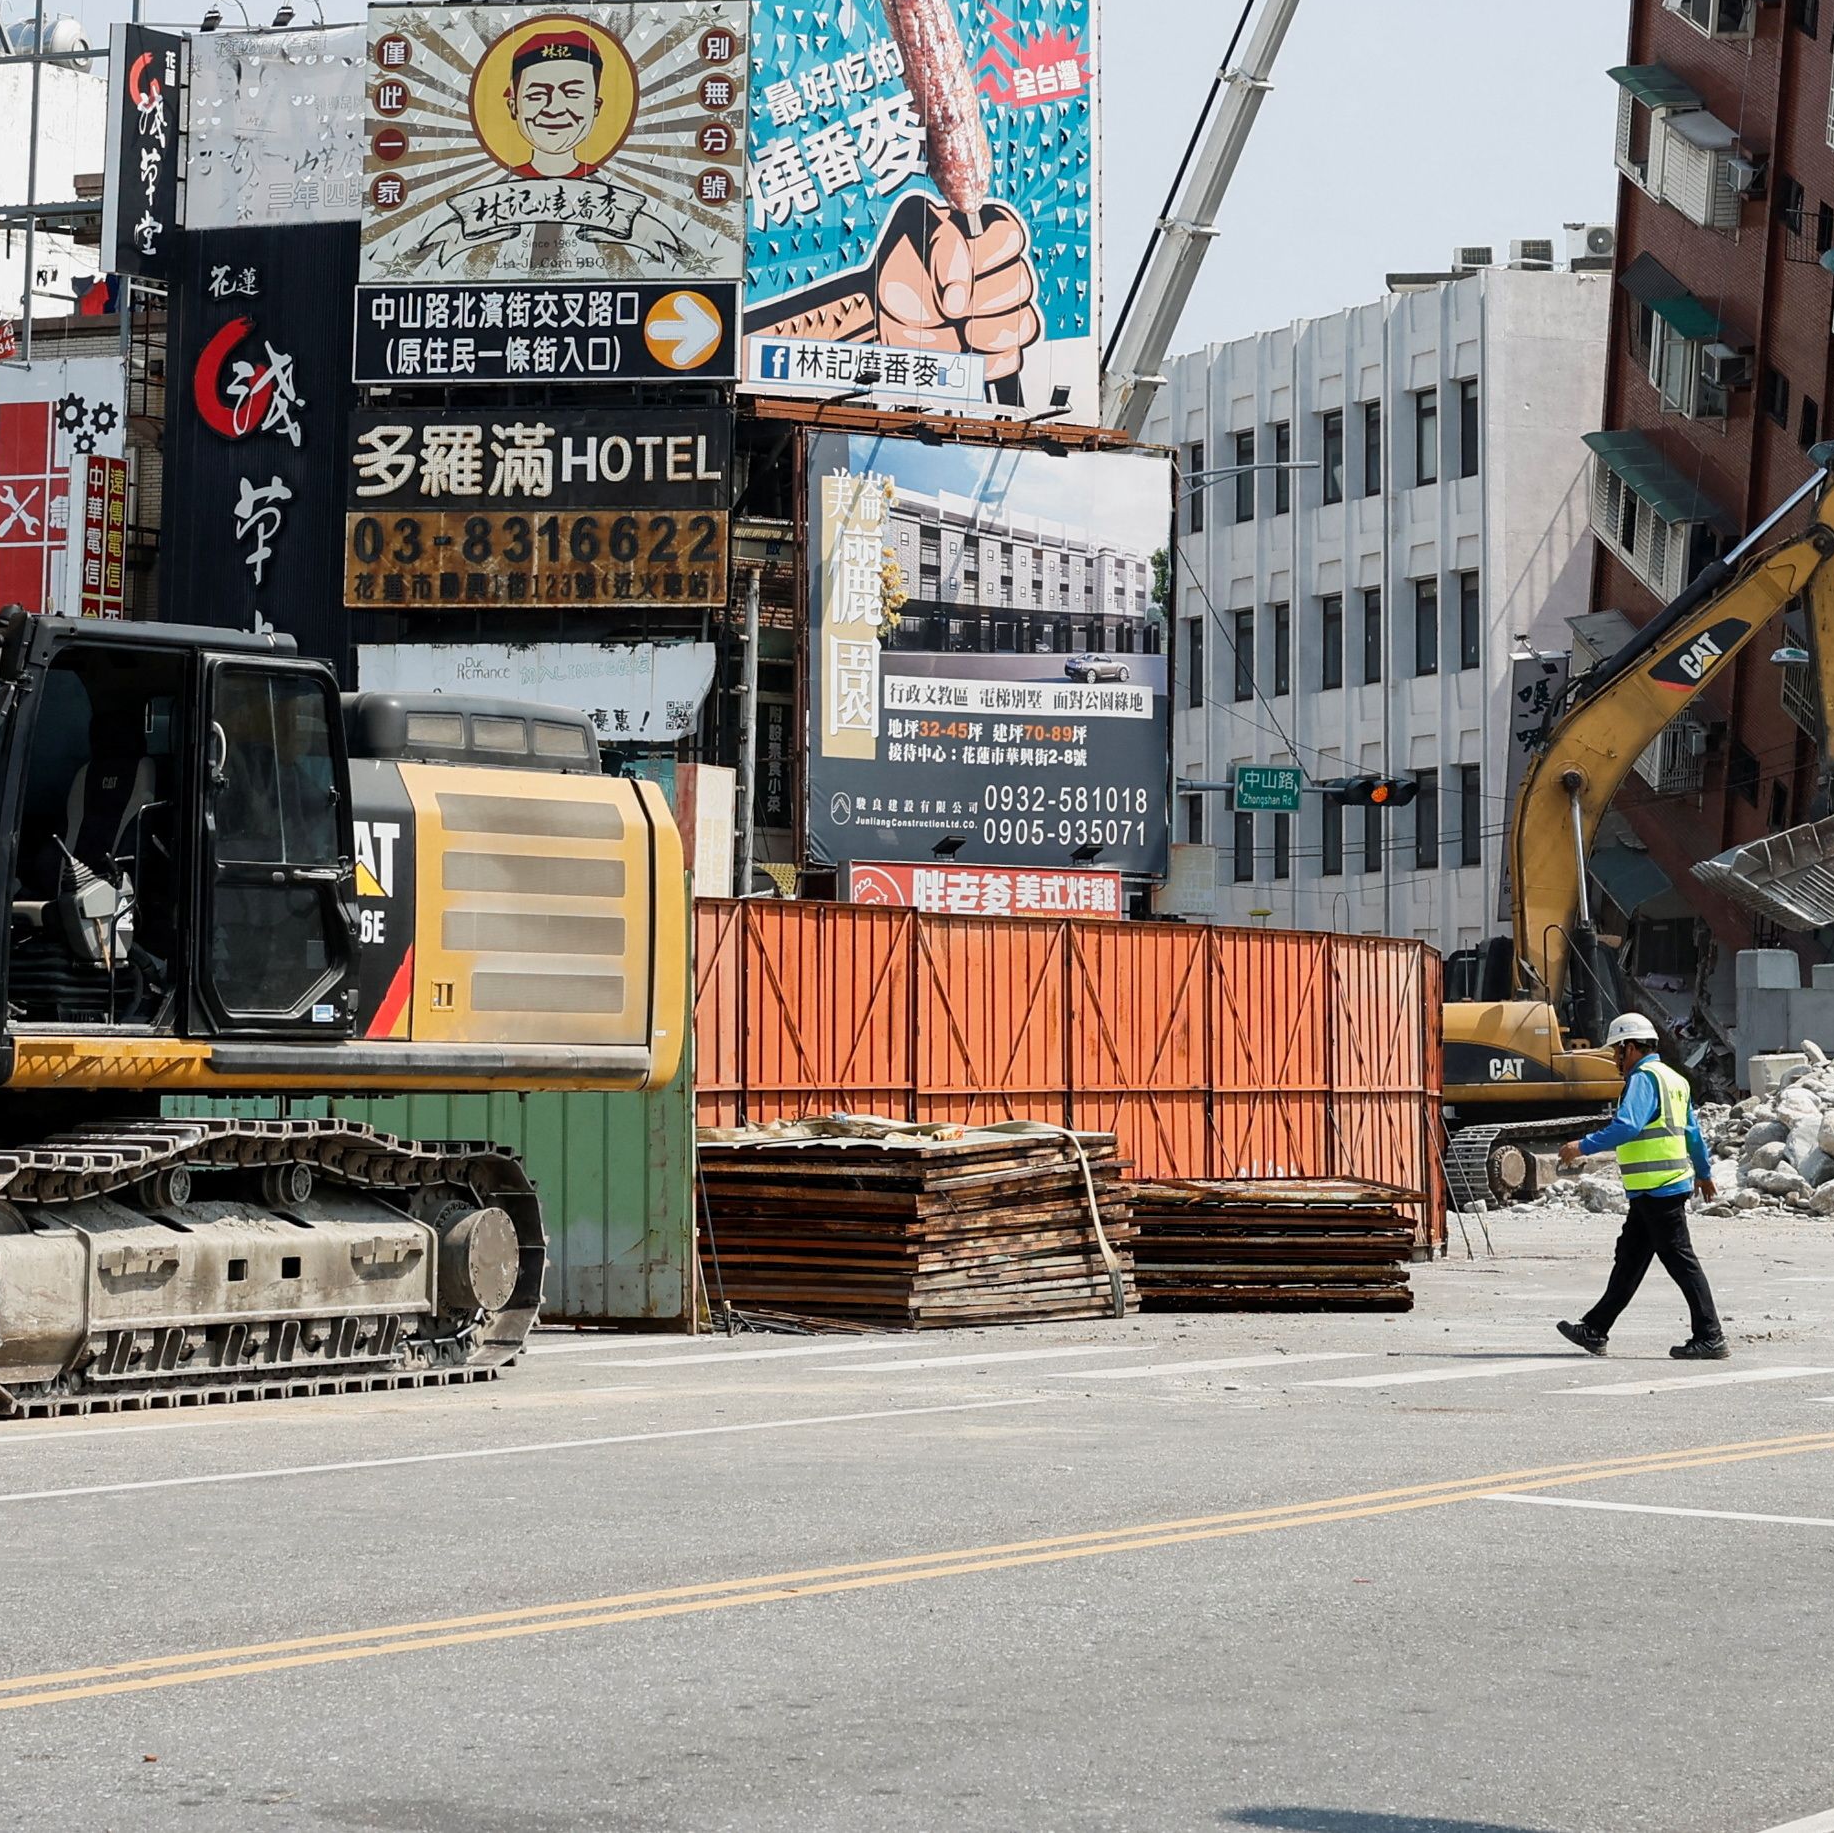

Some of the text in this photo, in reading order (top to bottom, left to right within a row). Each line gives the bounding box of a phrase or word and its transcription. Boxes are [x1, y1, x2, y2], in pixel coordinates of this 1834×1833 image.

[541, 44, 573, 59] 林記
[764, 38, 906, 127] 最好吃的
[1013, 60, 1082, 98] 全台灣
[376, 41, 407, 204] 僅此一家
[702, 35, 732, 201] 別無分號
[473, 184, 628, 226] 林記燒番麥
[521, 238, 578, 248] Since 1965
[576, 256, 607, 269] BBQ
[208, 265, 260, 297] 花蓮
[371, 291, 639, 331] 中山路北濱街交叉路口
[385, 336, 621, 376] (原住民一條街入口)
[353, 422, 723, 499] 多羅滿 HOTEL
[85, 465, 105, 586] 中華電信
[105, 467, 126, 590] 遠傳電信
[352, 515, 720, 564] 03-8316622
[1678, 631, 1724, 680] CAT
[888, 681, 1144, 713] 行政文教區 電梯別墅 面對公園綠地
[887, 719, 1088, 745] 地坪32-45坪 建坪70-89坪
[102, 776, 118, 790] CAT
[1244, 770, 1296, 790] 中山路
[855, 796, 980, 815] 駿良建設有限公司
[984, 784, 1148, 815] 0932-581018
[1243, 793, 1281, 808] Zhongshan
[983, 818, 1147, 847] 0905-935071
[352, 820, 400, 898] AT
[1489, 1057, 1525, 1081] CAT
